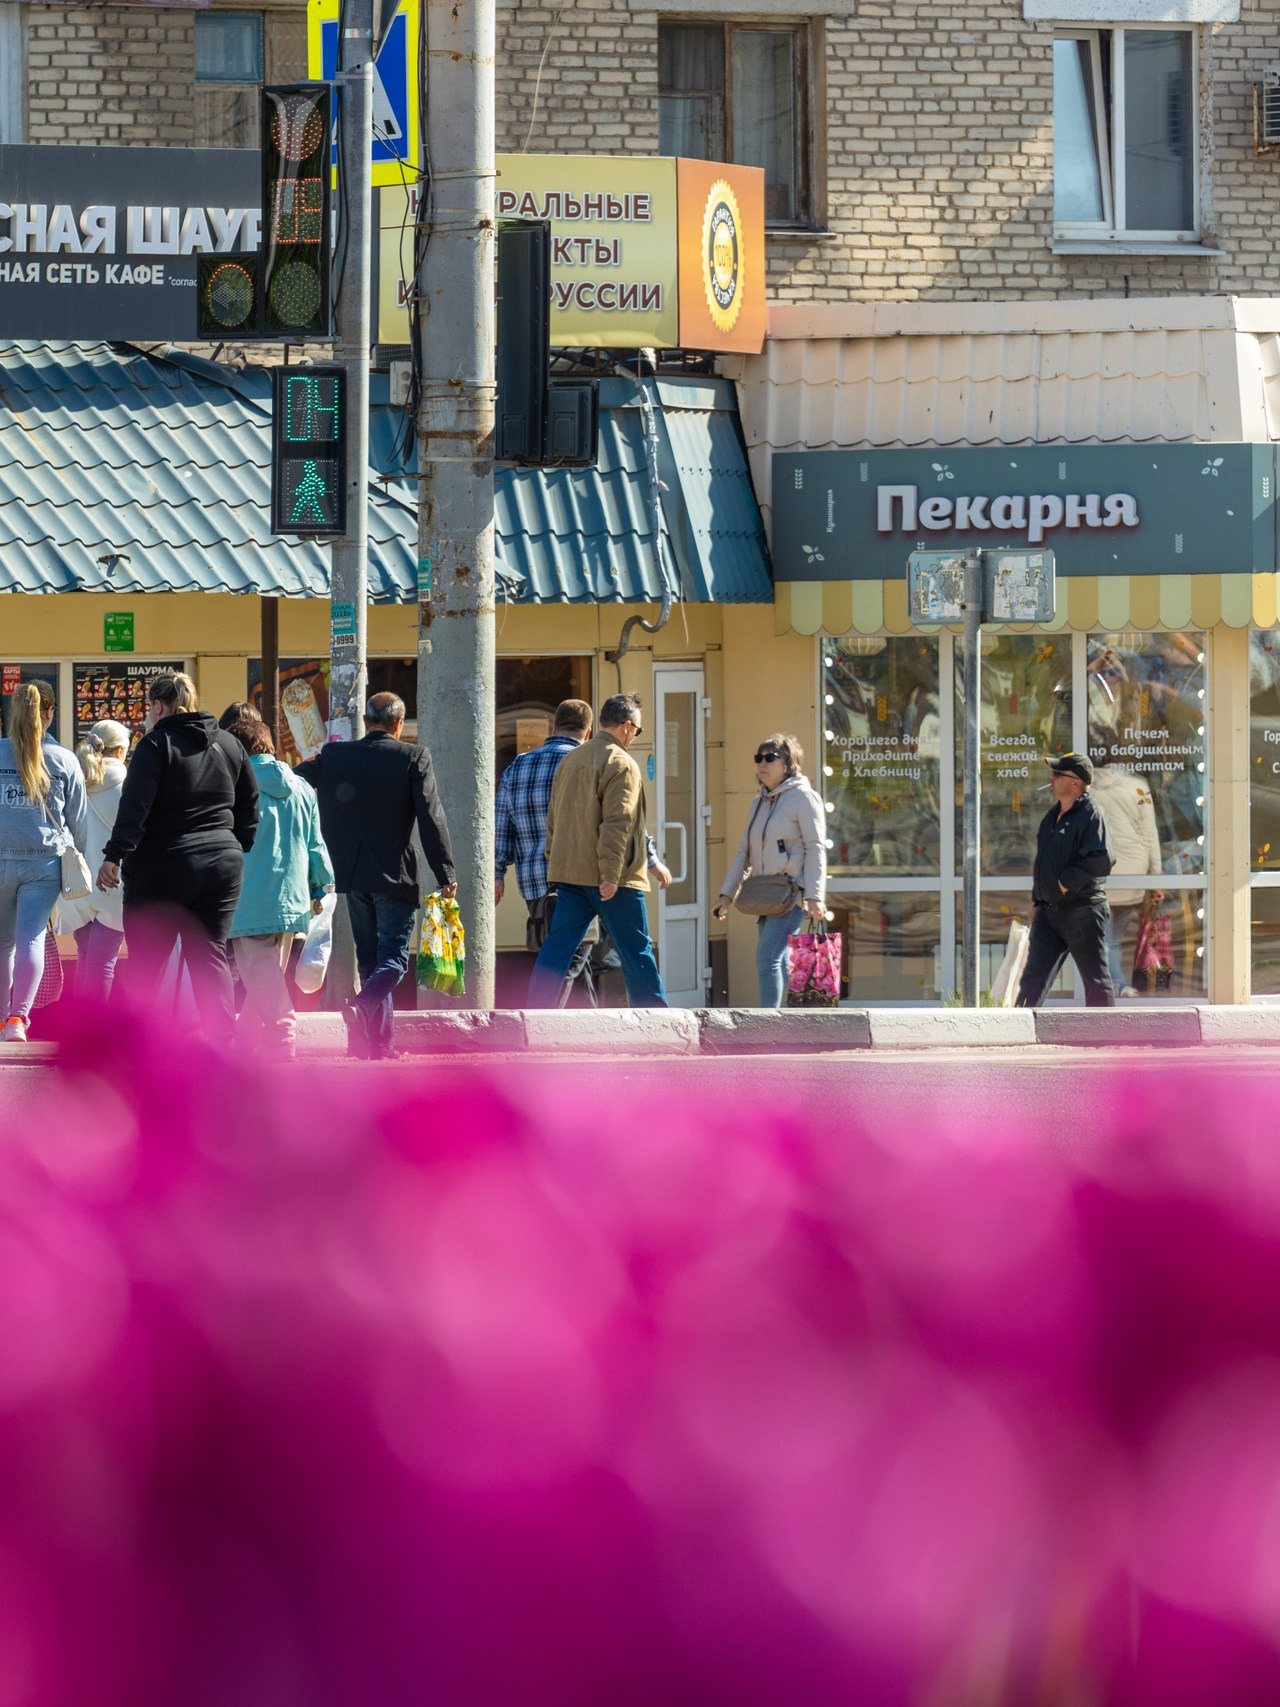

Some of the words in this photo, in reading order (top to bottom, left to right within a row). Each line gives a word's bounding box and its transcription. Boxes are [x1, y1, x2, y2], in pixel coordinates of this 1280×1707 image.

[46, 264, 99, 284] СЕТЬ
[105, 264, 164, 285] КАФЕ
[876, 484, 1139, 542] Пекарня
[333, 634, 354, 645] -0999
[127, 666, 175, 675] ШАУРМА
[989, 734, 1036, 746] Всегда
[1124, 727, 1170, 740] Печем
[831, 735, 899, 749] Хорошего
[842, 750, 921, 764] Приходите
[987, 750, 1038, 762] свежий
[1089, 746, 1107, 757] по
[1110, 744, 1204, 759] бабушкиным
[842, 768, 850, 777] в
[854, 766, 921, 780] Хлебницу
[996, 766, 1029, 778] хлеб
[1109, 761, 1185, 774] рецептам
